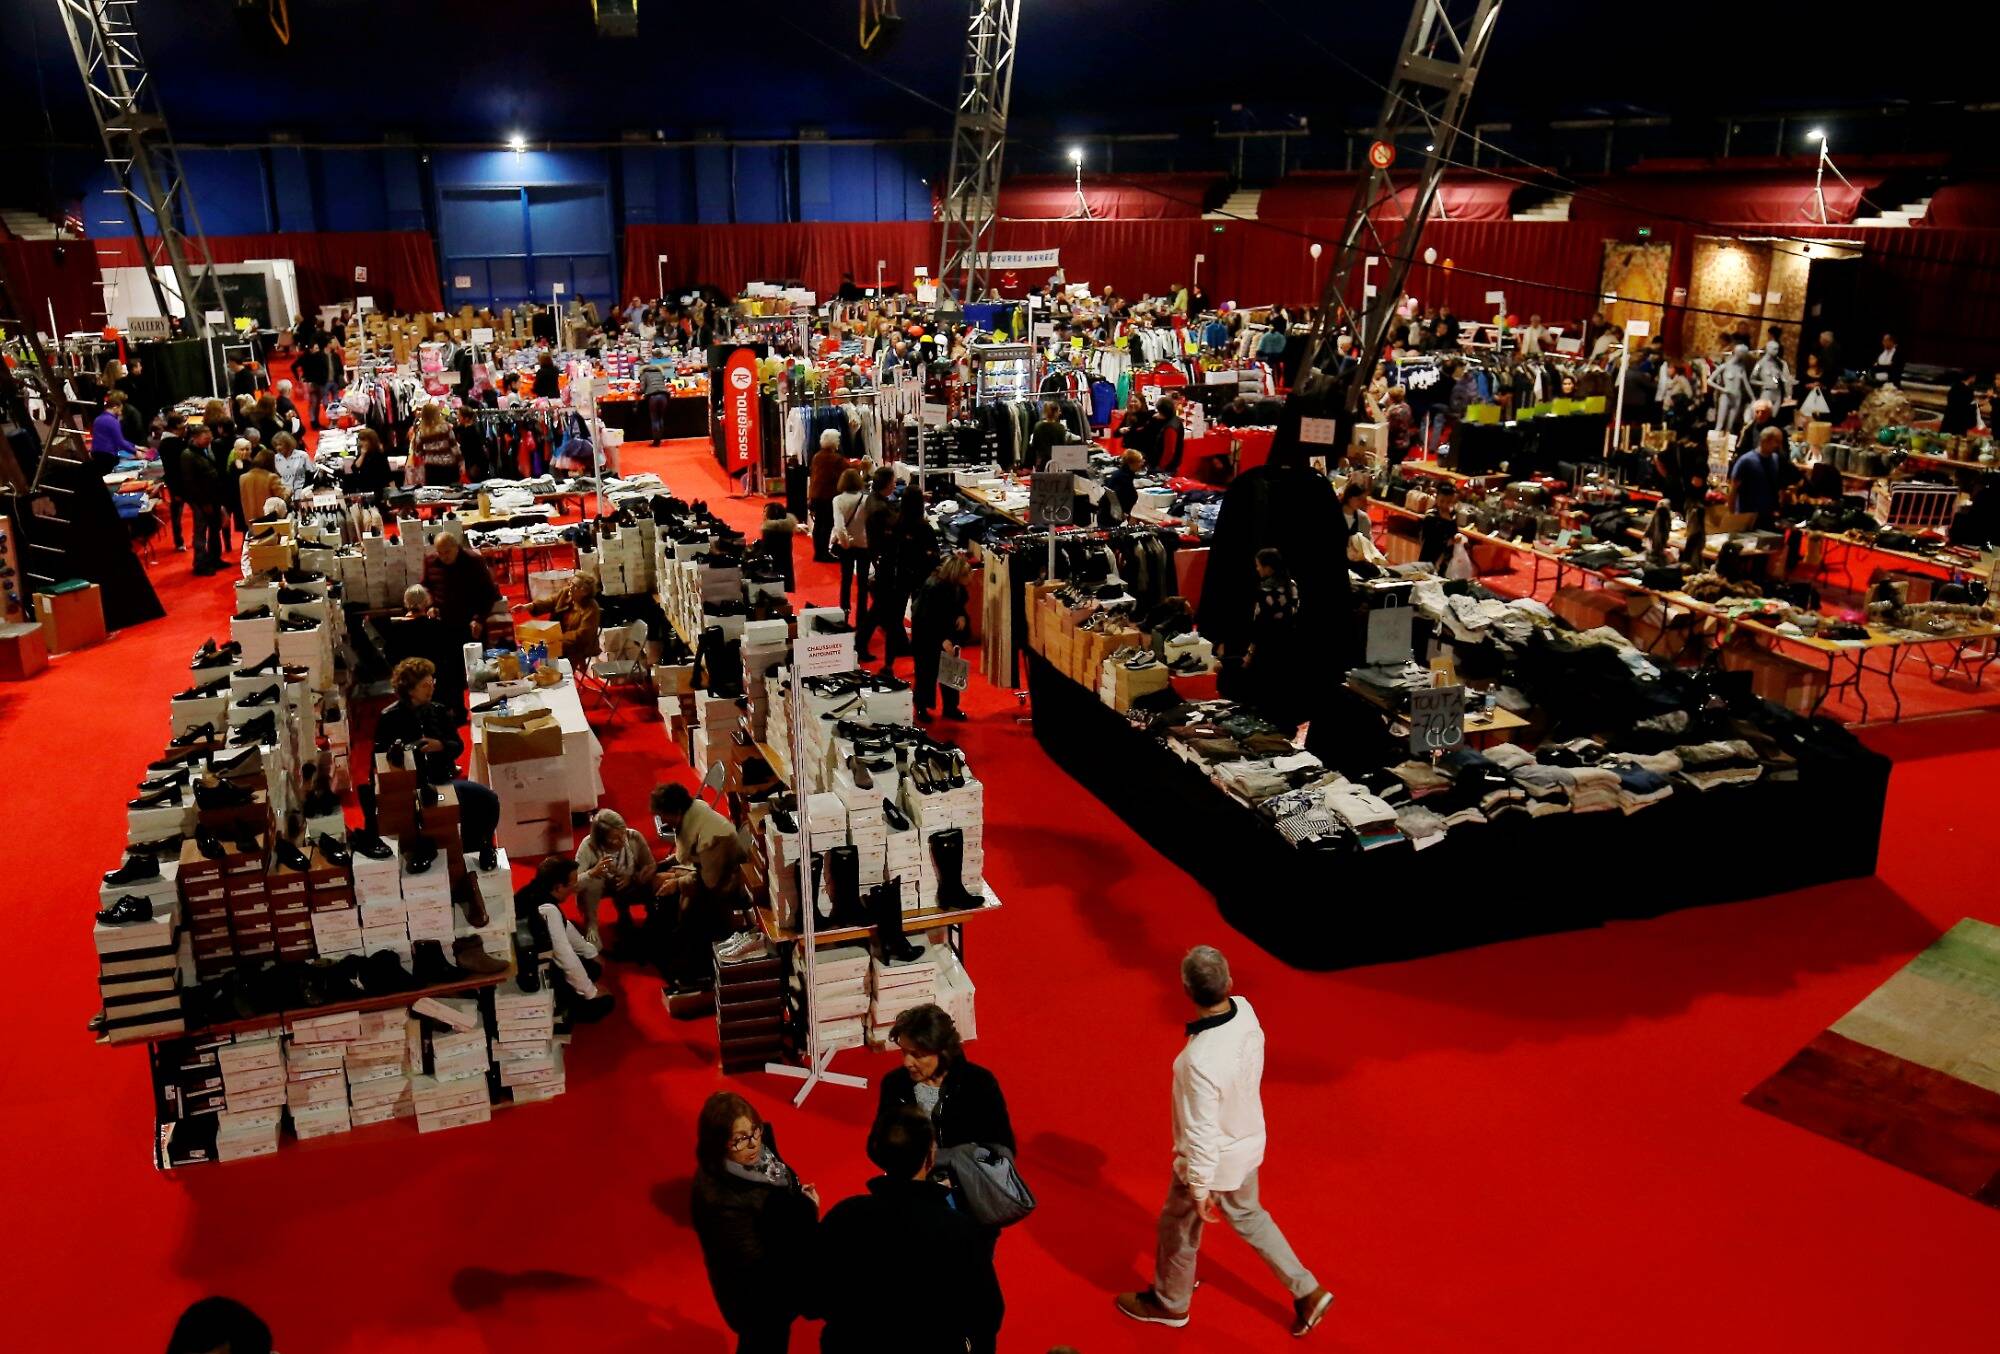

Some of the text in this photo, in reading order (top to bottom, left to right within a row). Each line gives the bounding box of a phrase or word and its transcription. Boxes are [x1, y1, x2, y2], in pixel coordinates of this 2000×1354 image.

[130, 320, 165, 331] GALLERY
[736, 392, 749, 460] ROSSIGNOL
[807, 643, 842, 652] CHAUSSURES
[1413, 693, 1454, 710] TOUT
